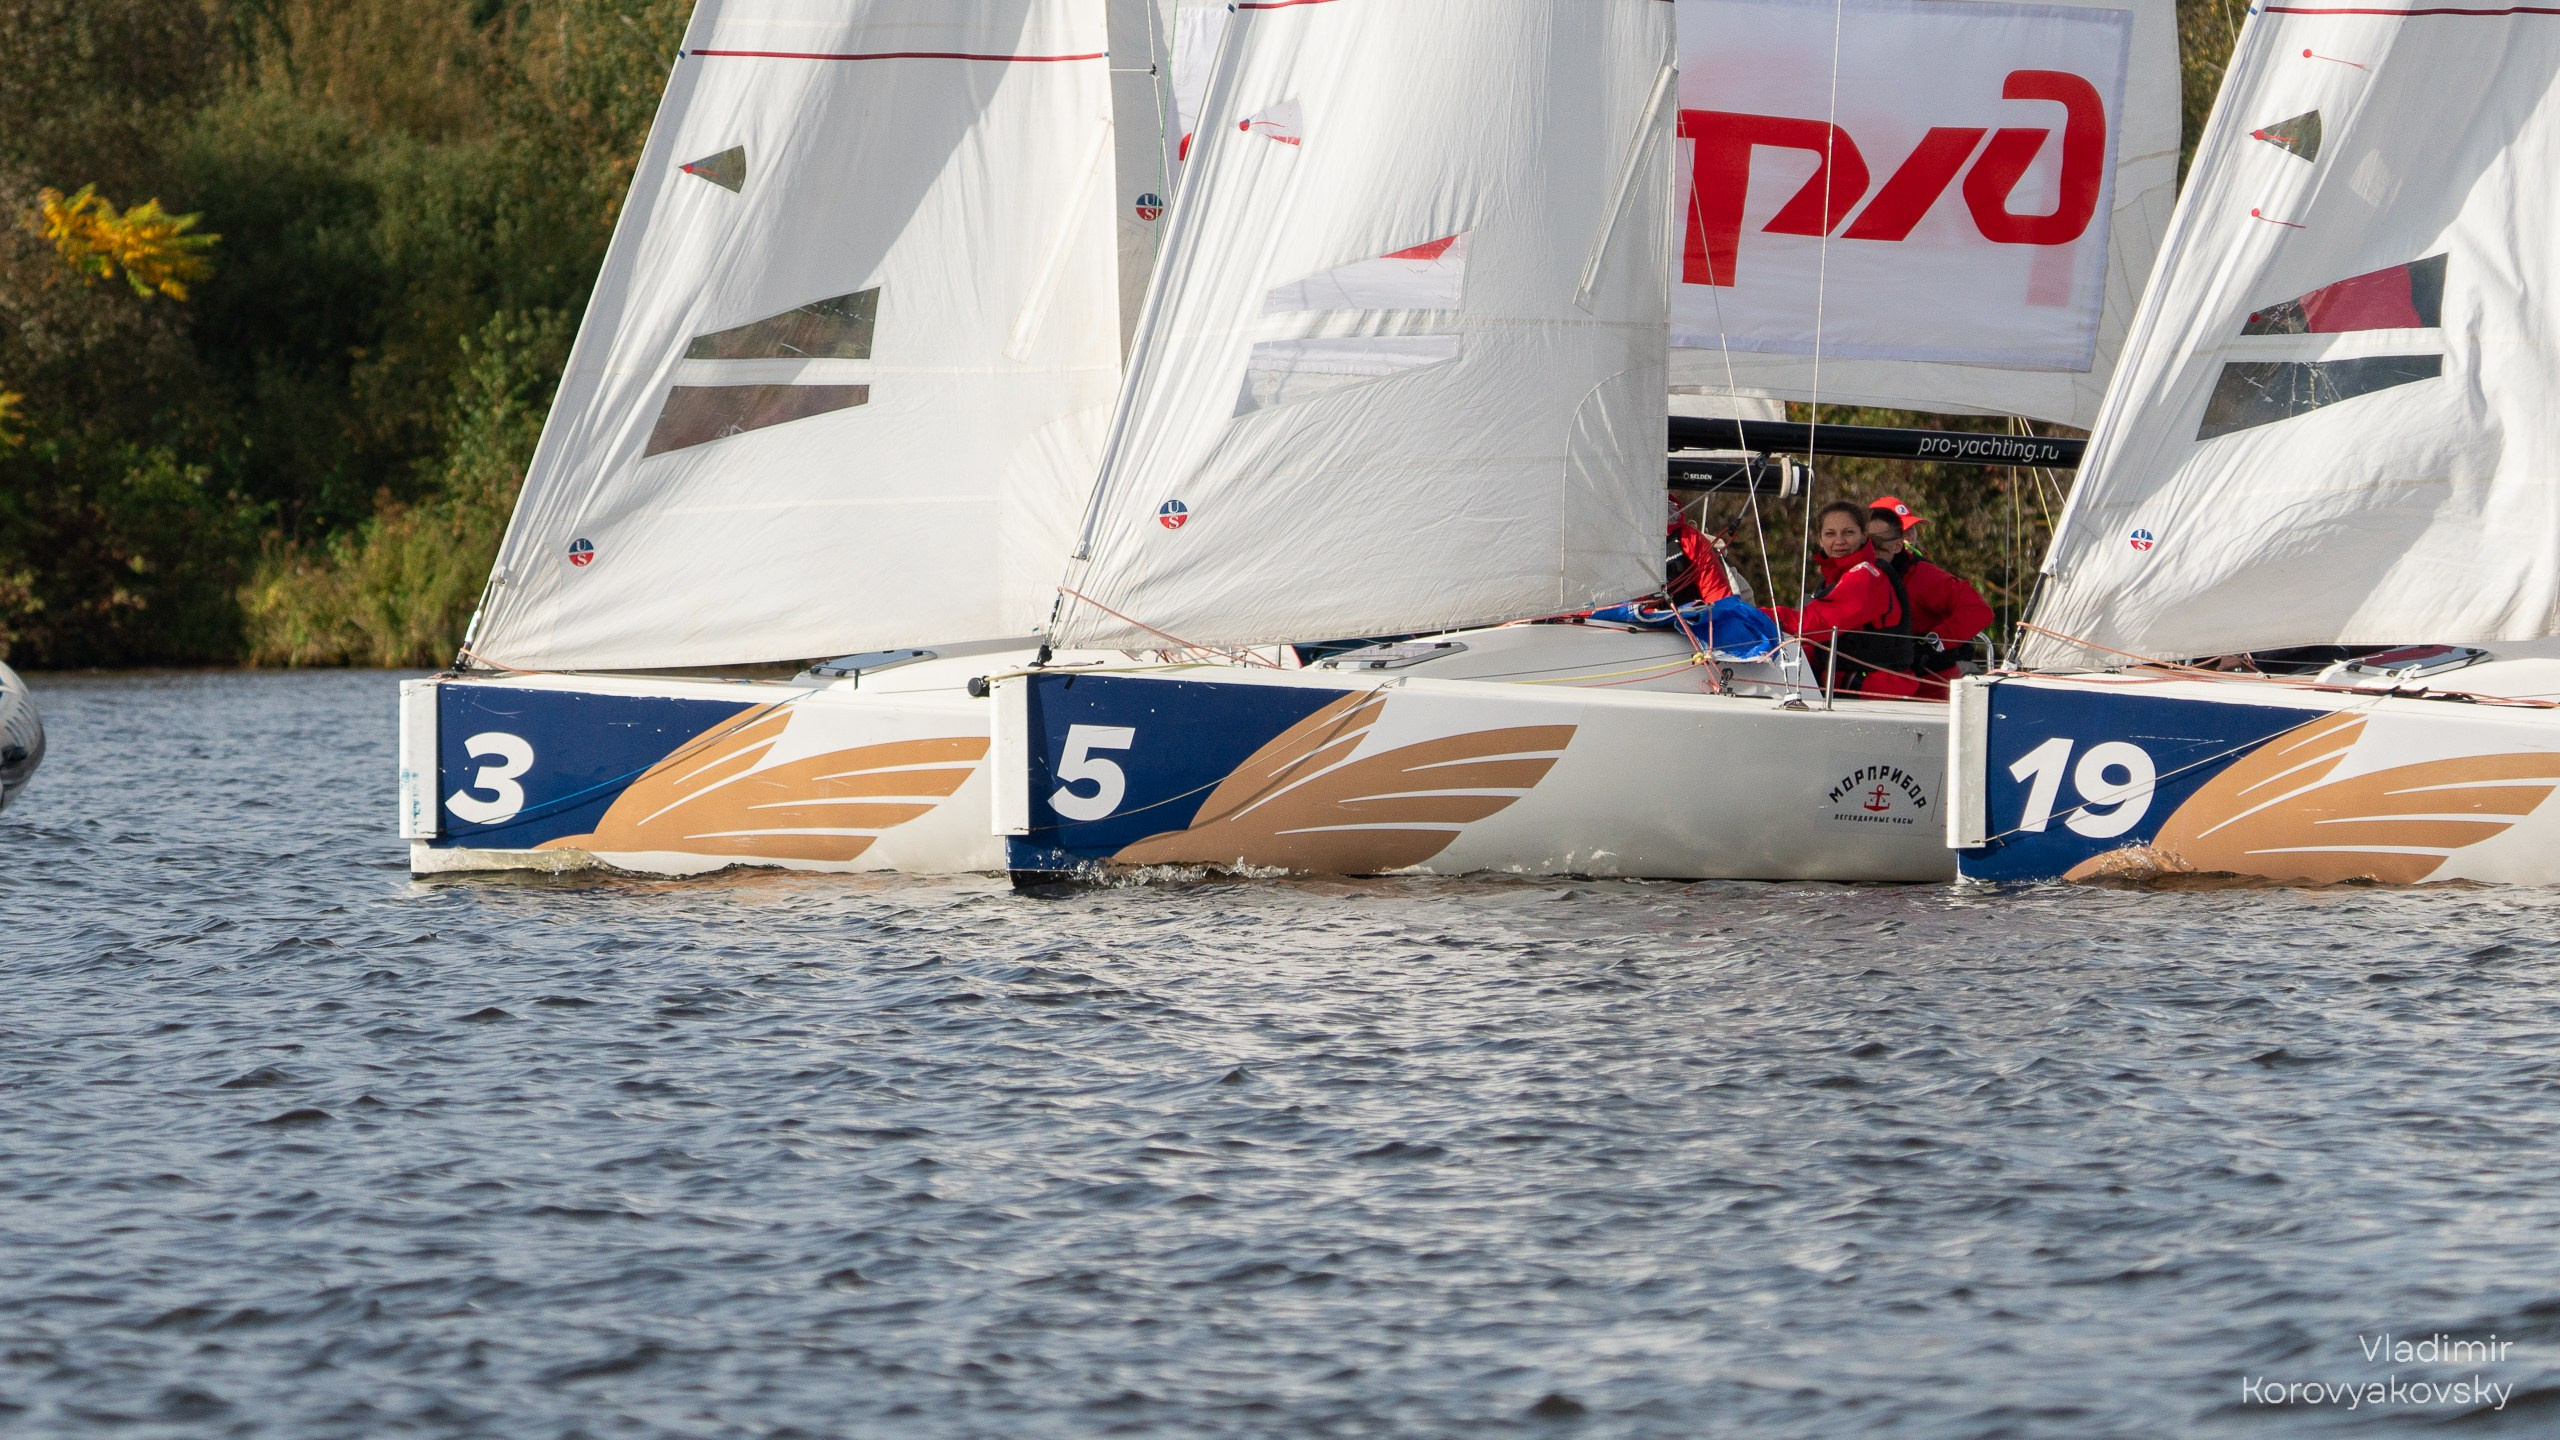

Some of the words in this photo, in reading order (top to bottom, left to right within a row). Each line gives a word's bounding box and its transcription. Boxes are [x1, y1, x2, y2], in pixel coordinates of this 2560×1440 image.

[1917, 437, 2060, 463] pro-yachting.ru
[444, 732, 534, 825] 3
[1047, 724, 1135, 822] 5
[1829, 765, 1927, 809] МОРПРИБОР
[2008, 737, 2156, 838] 19
[1834, 813, 1889, 824] ЛЕГЕНДАРНЫЕ
[1892, 817, 1914, 825] ЧАСЫ
